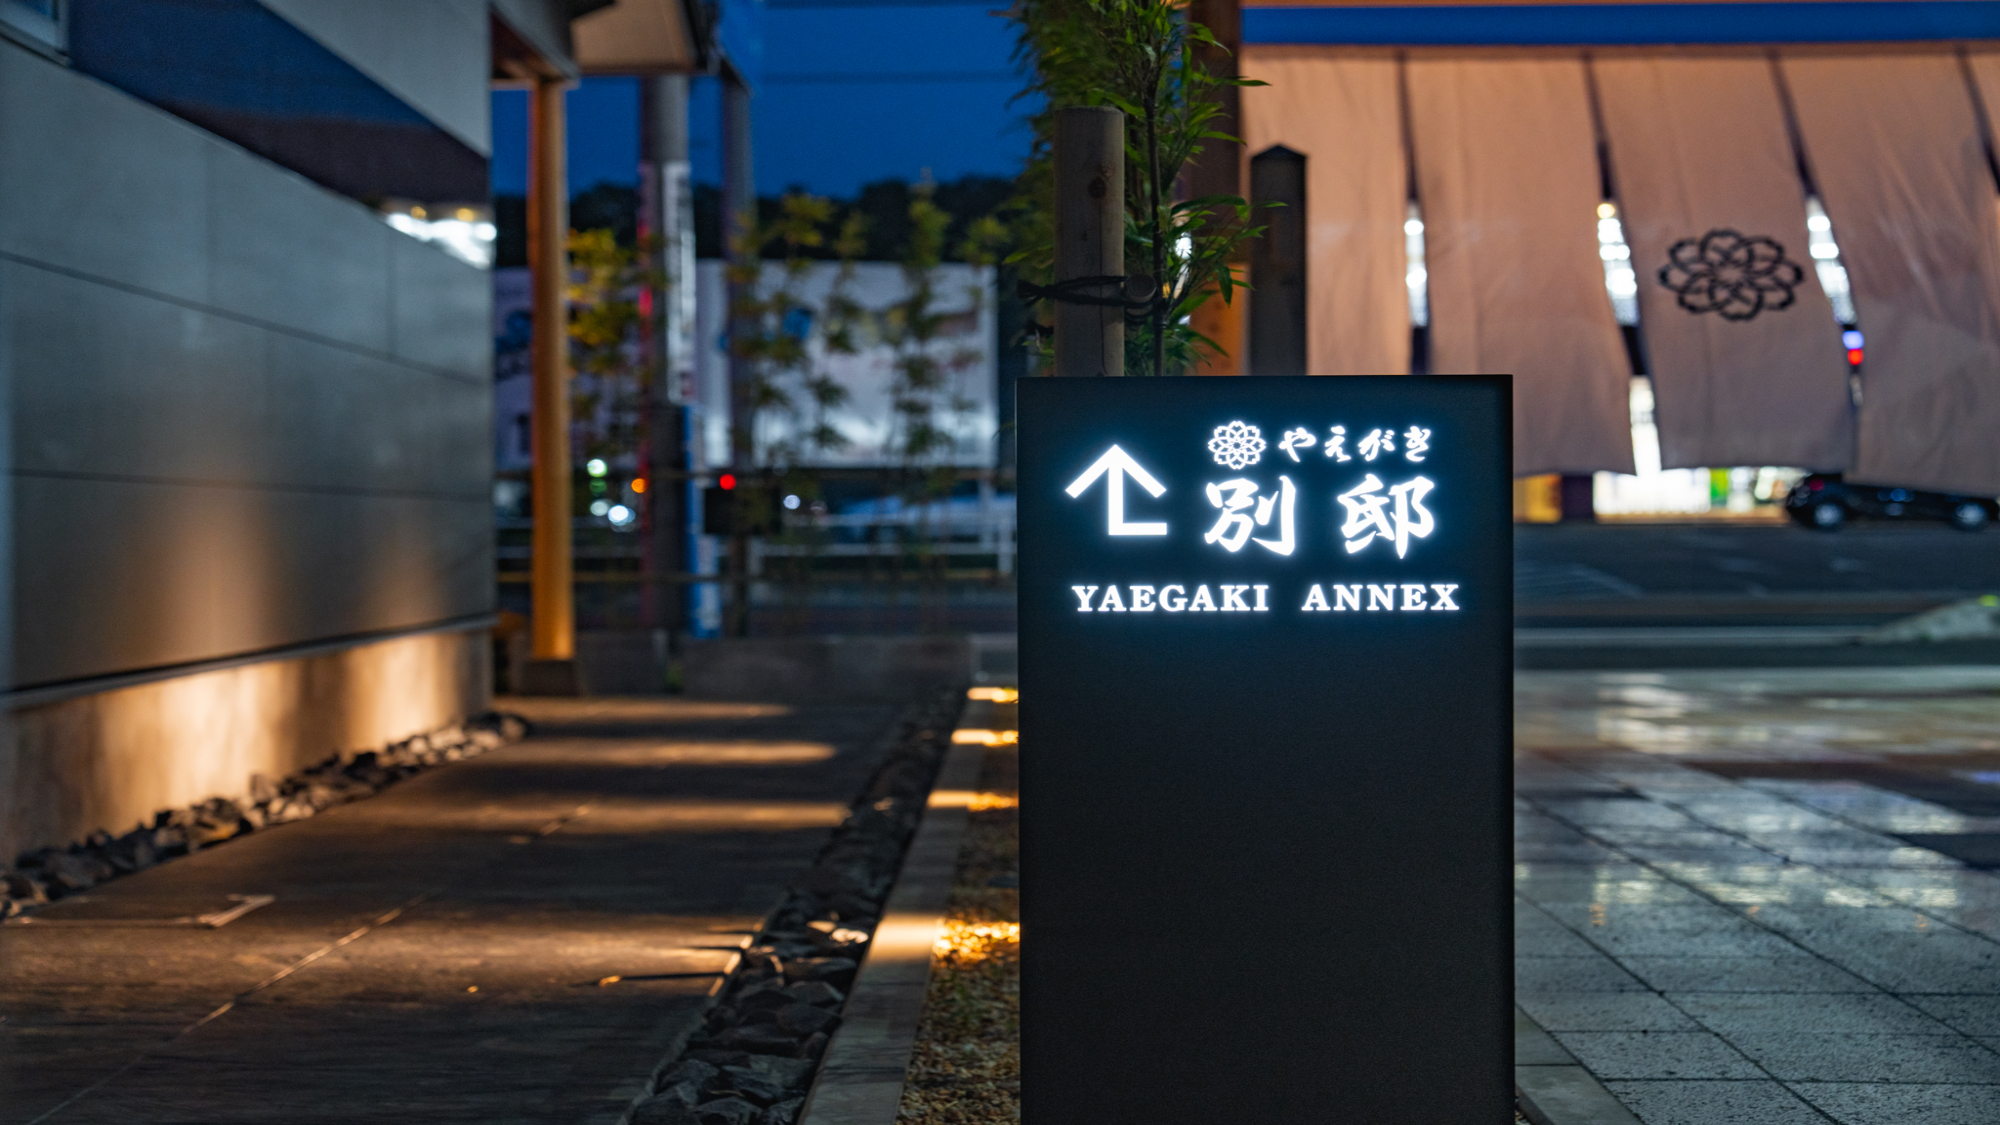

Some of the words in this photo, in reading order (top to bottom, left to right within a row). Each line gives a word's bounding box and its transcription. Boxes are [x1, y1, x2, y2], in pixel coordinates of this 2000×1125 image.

[1277, 424, 1432, 463] やえがき
[1203, 473, 1436, 560] 別邸
[1071, 584, 1269, 612] YAEGAKI
[1301, 583, 1460, 612] ANNEX
